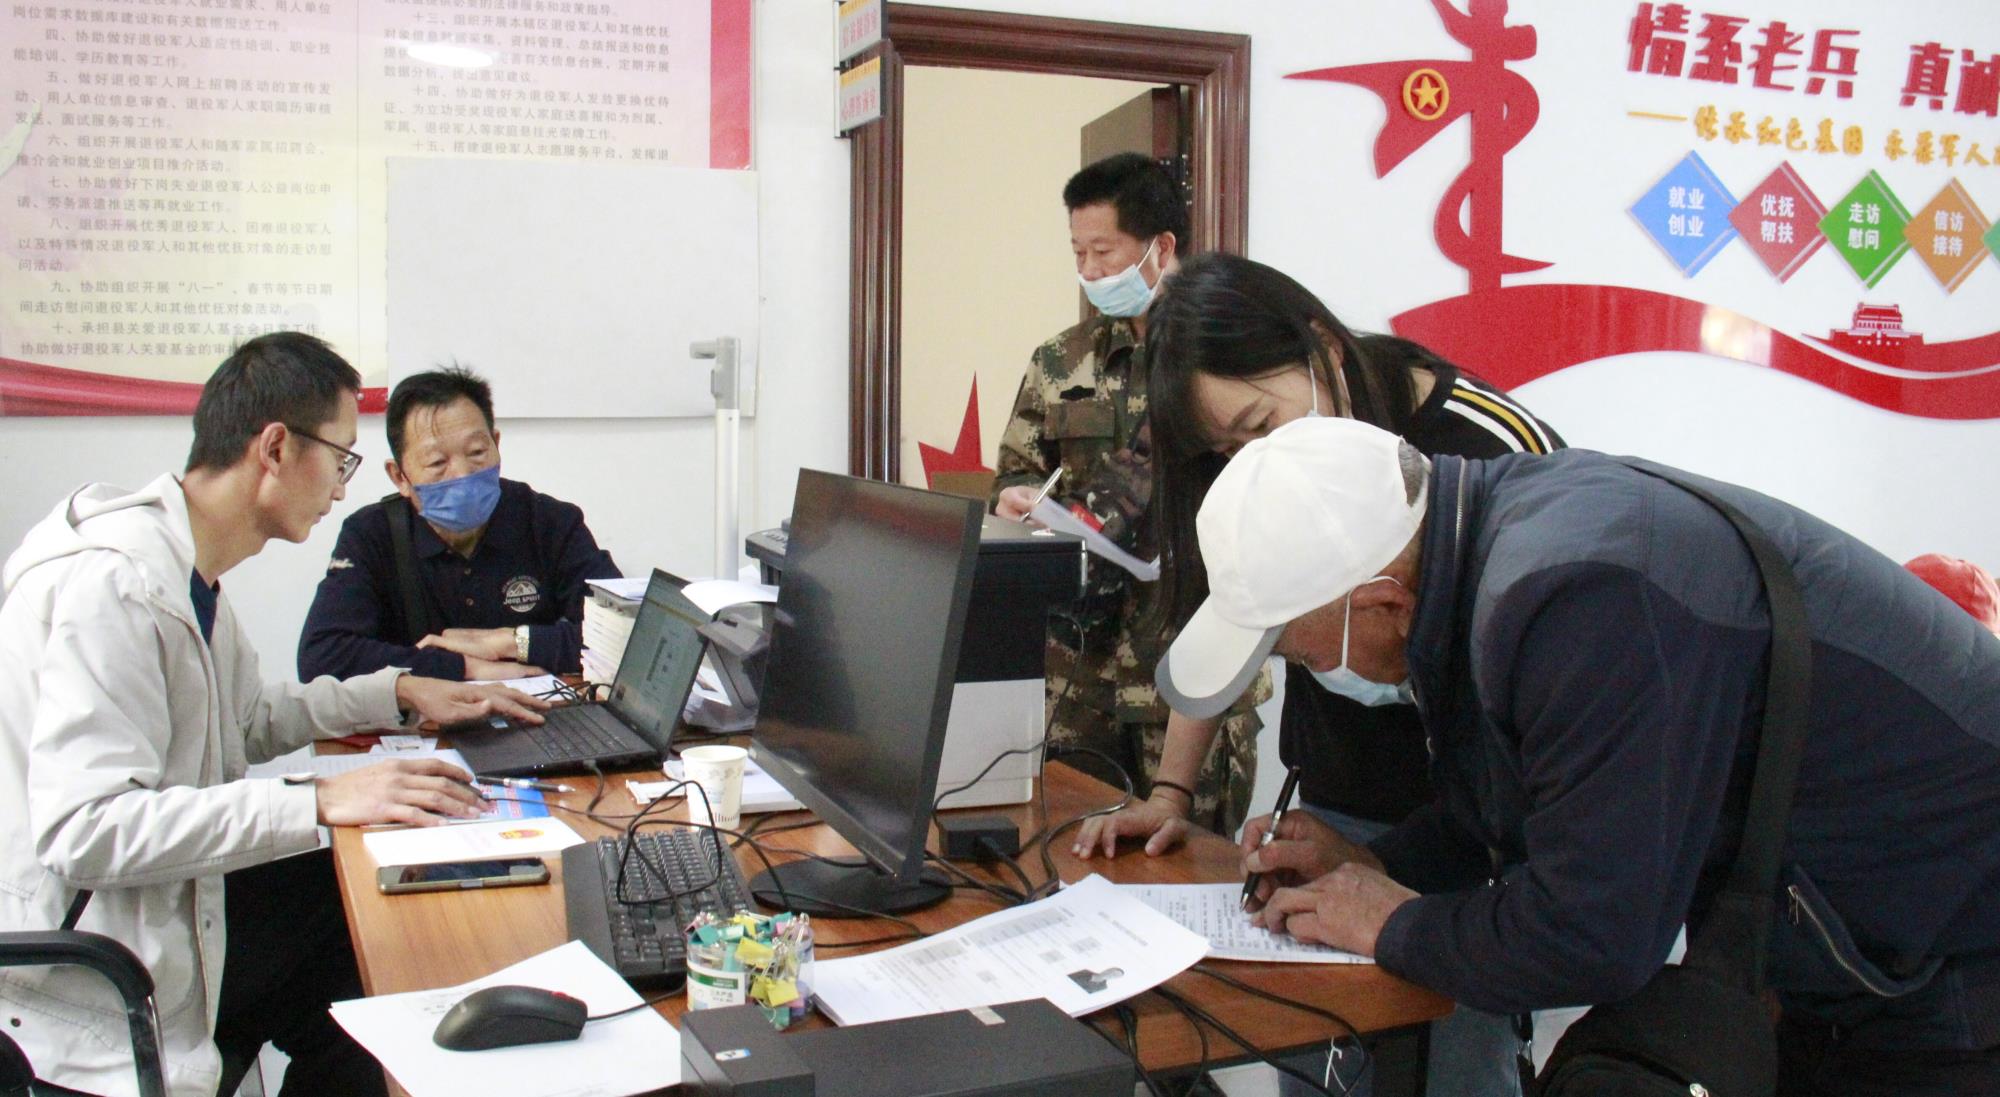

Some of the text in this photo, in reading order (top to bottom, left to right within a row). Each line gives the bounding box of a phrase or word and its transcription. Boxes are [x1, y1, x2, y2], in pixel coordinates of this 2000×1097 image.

[1627, 2, 1860, 99] 情系老兵
[1884, 129, 2000, 168] 永葆军人
[1668, 186, 1704, 210] 就业
[1761, 194, 1795, 218] 优抚
[1668, 214, 1704, 238] 创业
[1848, 203, 1881, 226] 走访
[1934, 209, 1964, 233] 信访
[1761, 220, 1794, 244] 帮扶
[1847, 228, 1880, 251] 慰问
[1932, 235, 1963, 257] 接待
